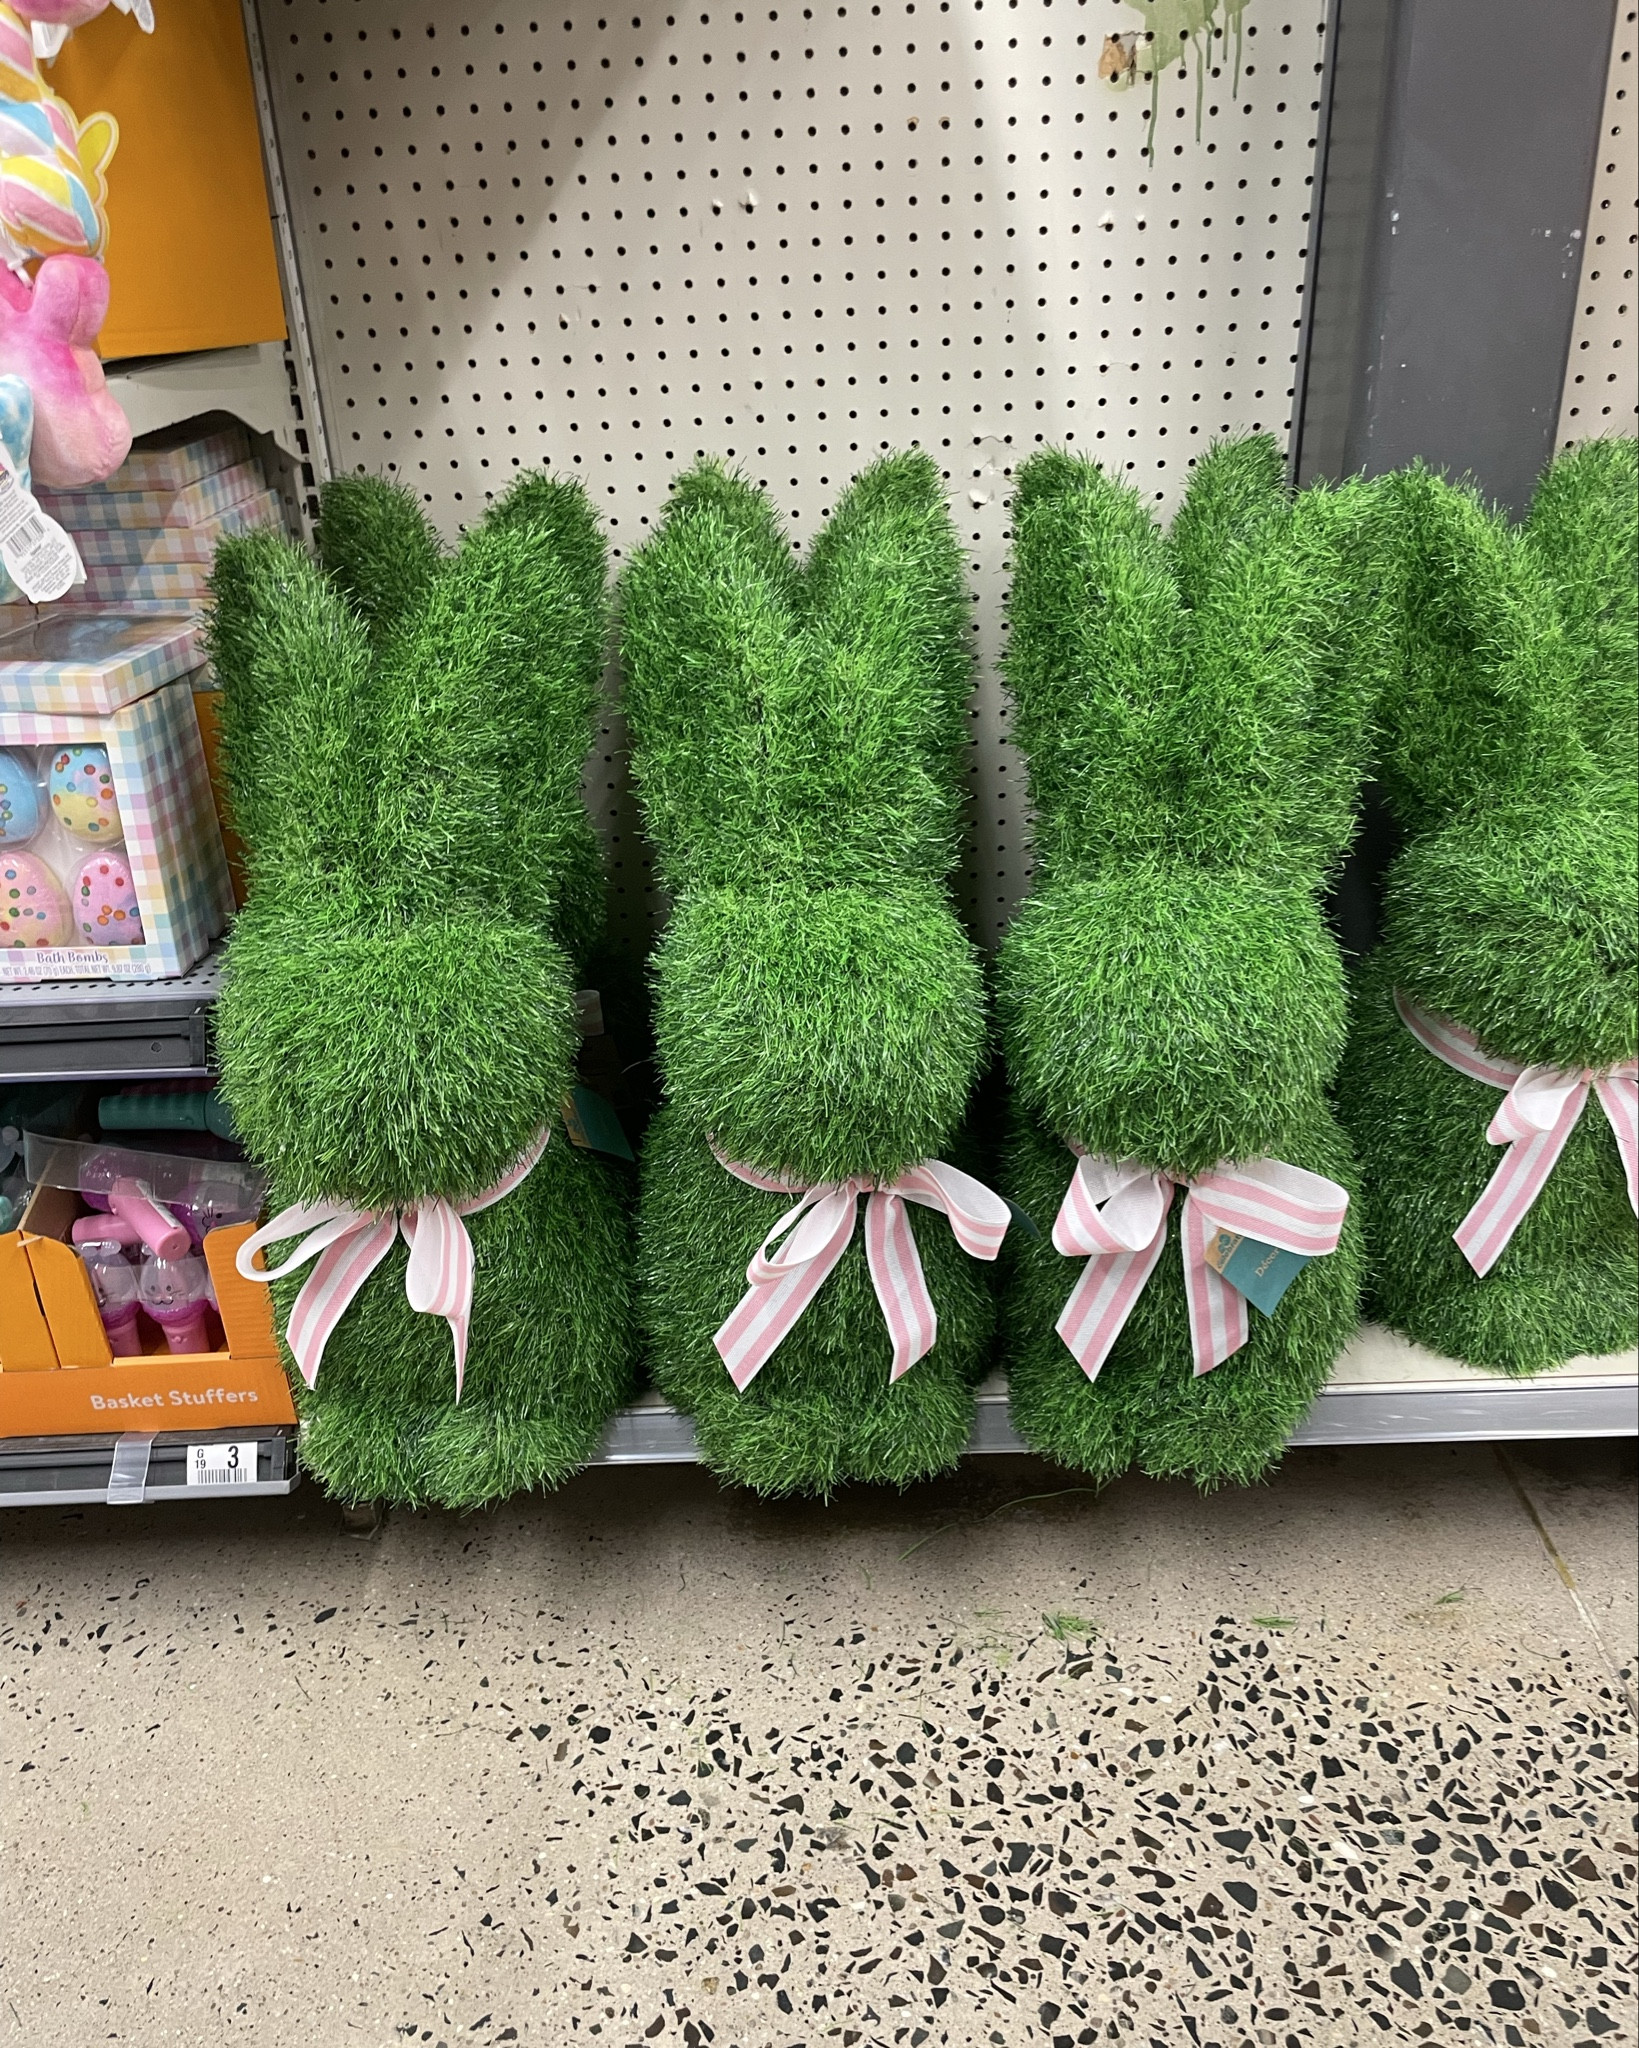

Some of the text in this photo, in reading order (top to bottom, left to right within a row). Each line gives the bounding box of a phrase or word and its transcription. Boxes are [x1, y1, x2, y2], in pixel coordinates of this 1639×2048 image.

[37, 950, 108, 964] Bath Bombs
[91, 1388, 258, 1410] Basket Stuffers
[197, 1448, 204, 1459] G
[227, 1445, 239, 1469] 3
[194, 1459, 206, 1469] 19
